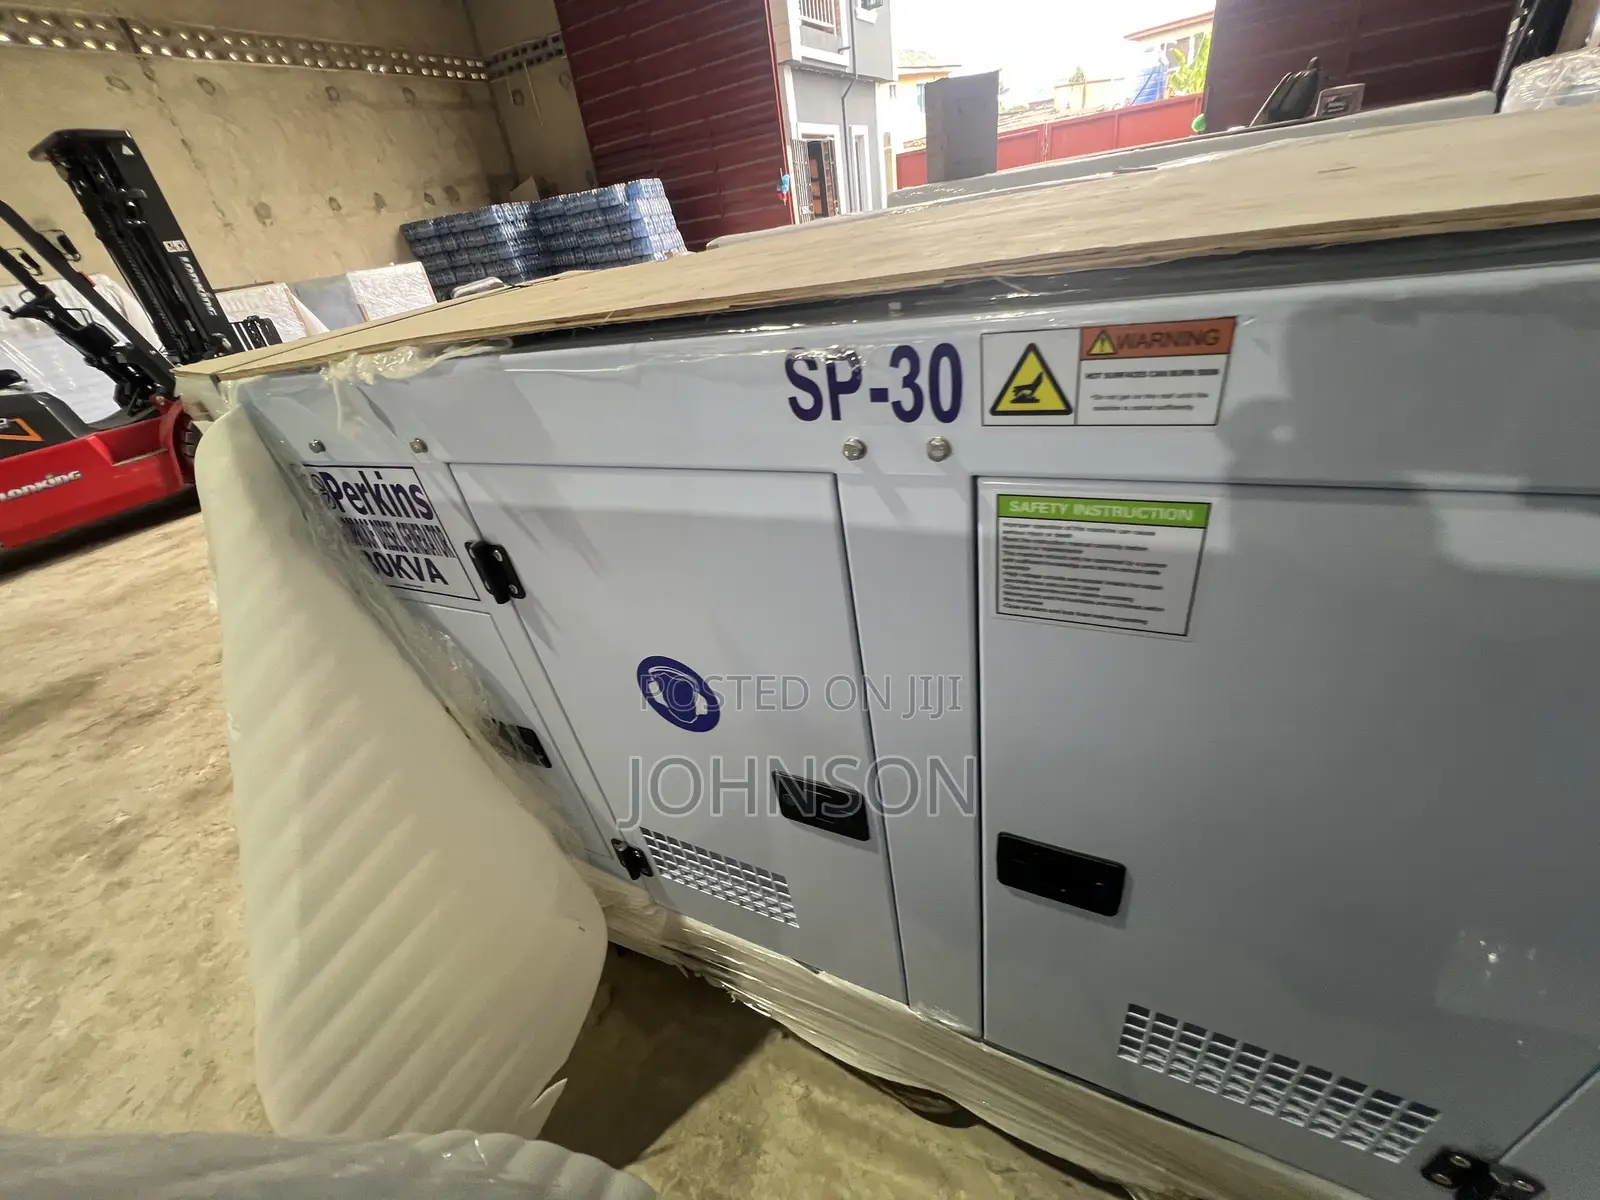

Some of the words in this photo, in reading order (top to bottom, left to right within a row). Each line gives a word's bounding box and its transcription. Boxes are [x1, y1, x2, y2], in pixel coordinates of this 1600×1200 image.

[1116, 329, 1221, 350] WARNING
[785, 343, 962, 423] SP-30
[318, 470, 434, 520] Perkins
[1008, 500, 1069, 515] SAFETY
[1073, 503, 1194, 521] INSTRUCTION
